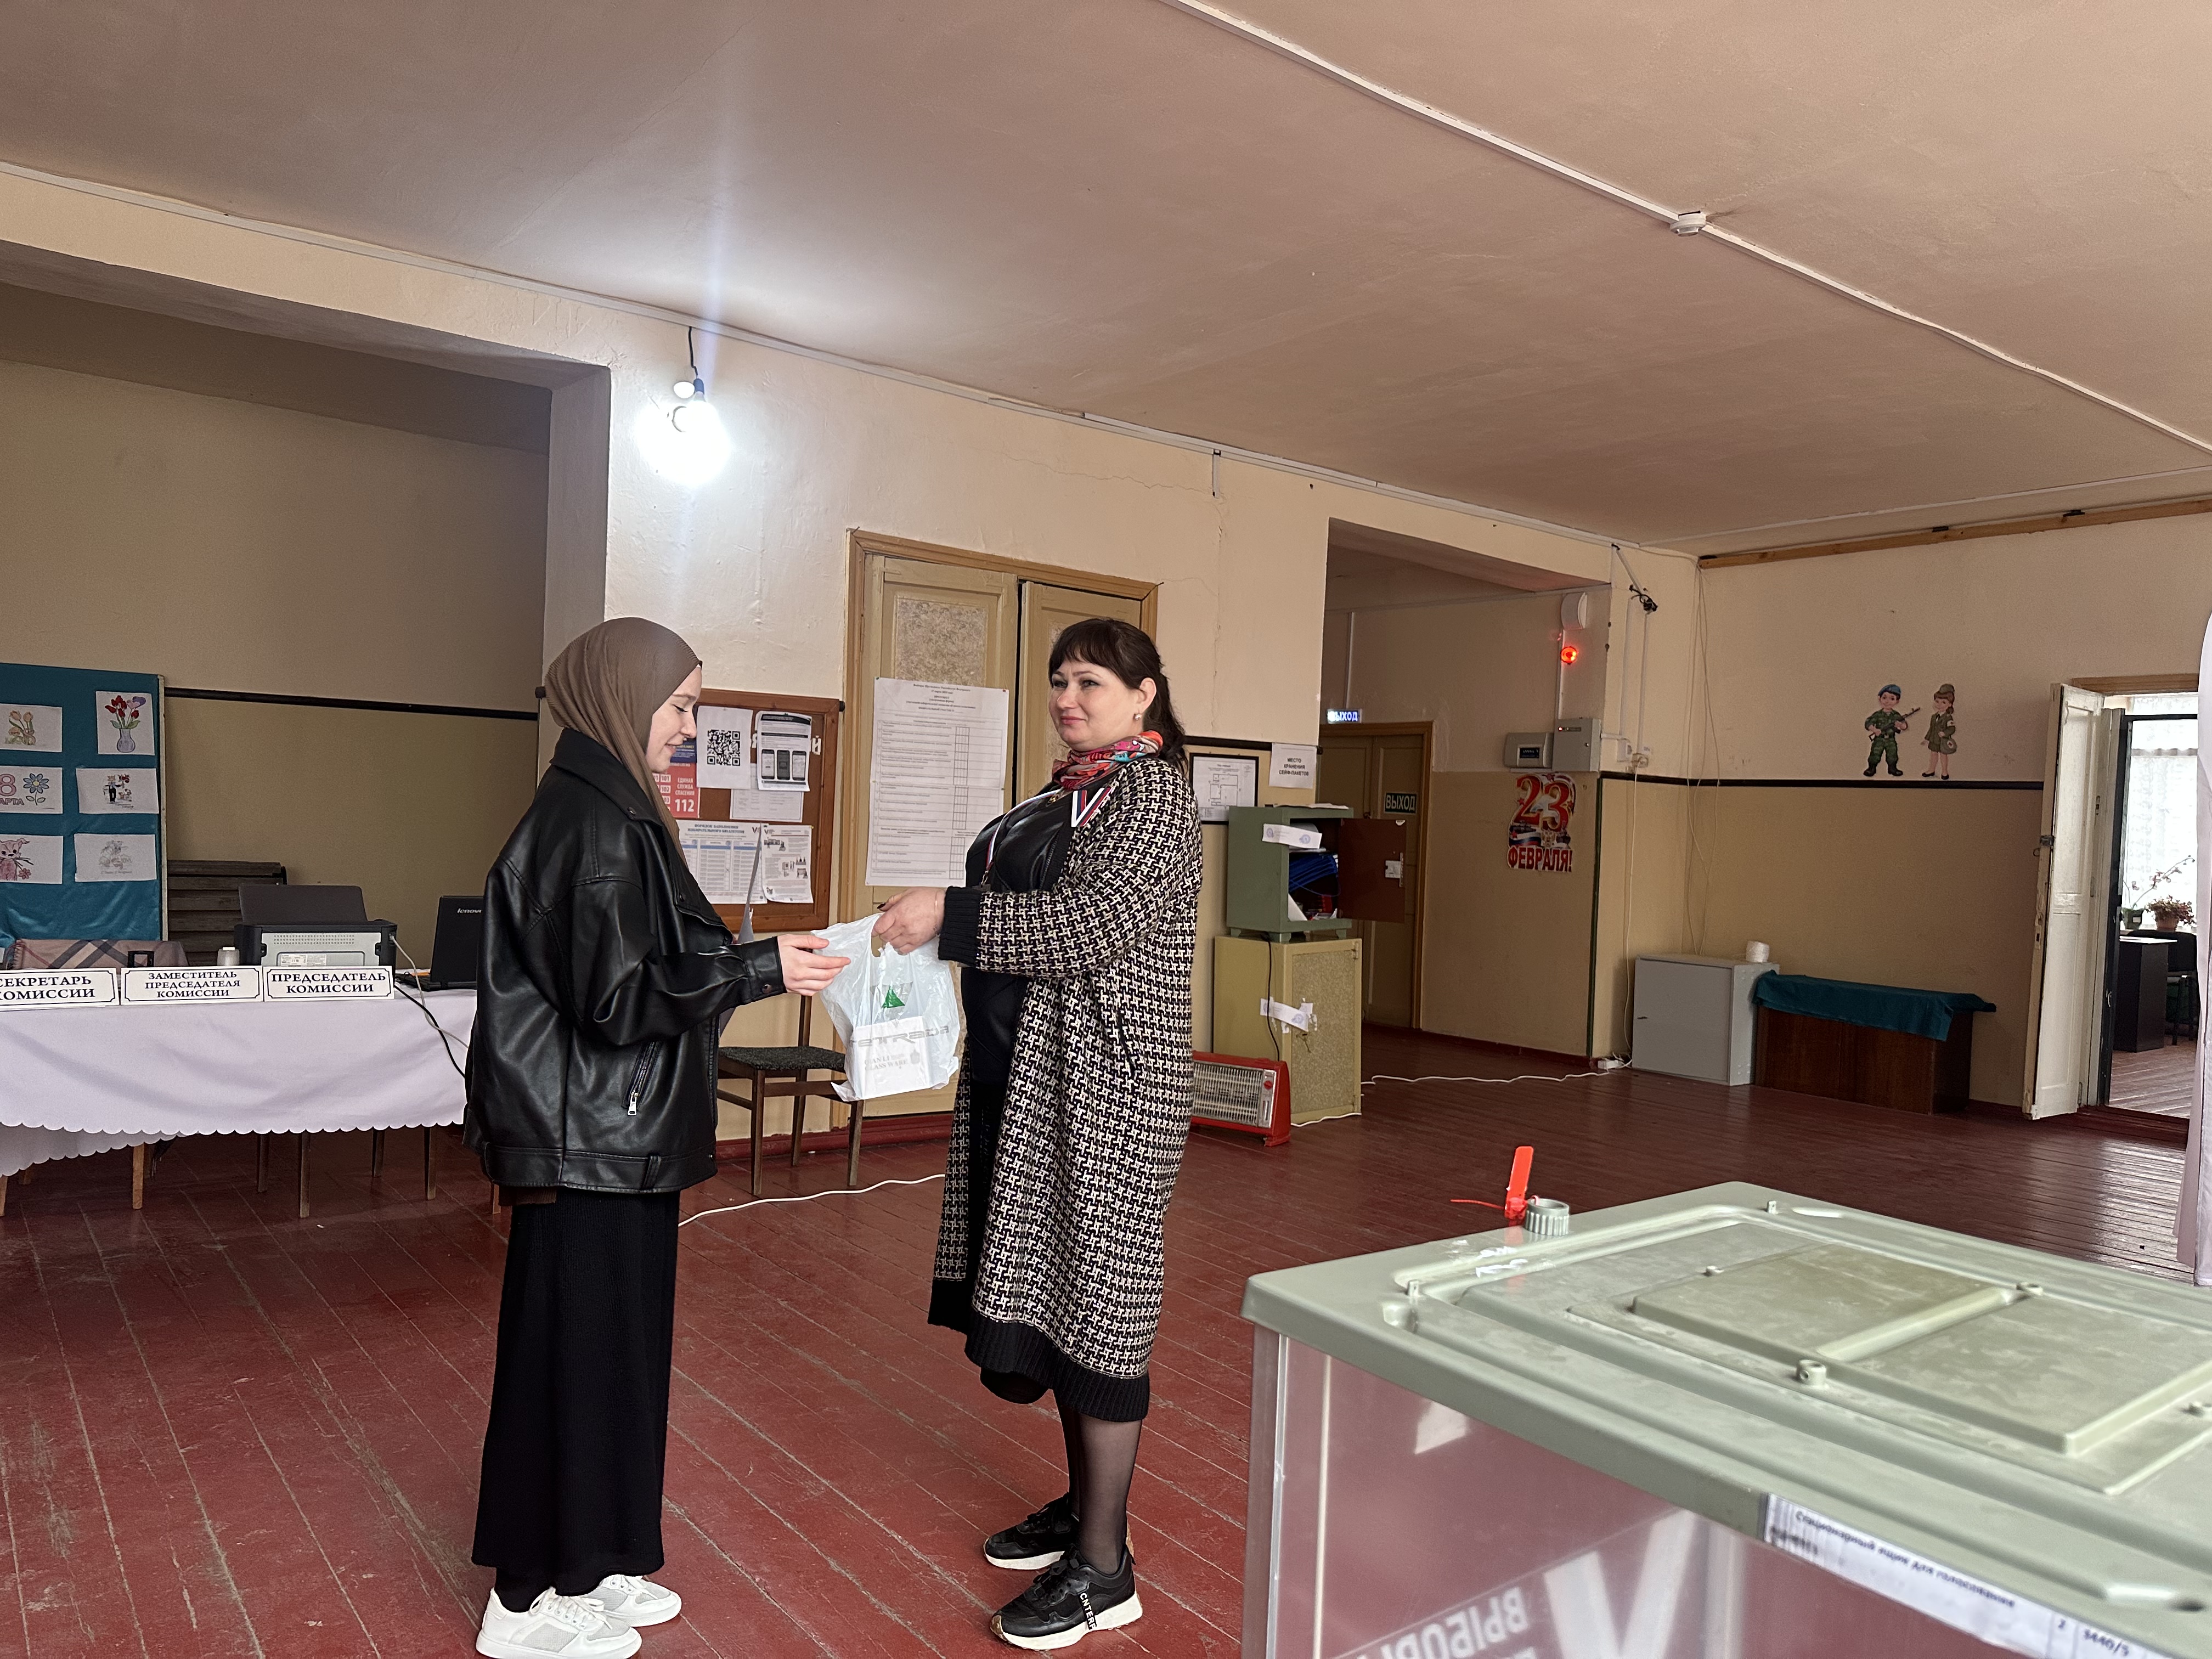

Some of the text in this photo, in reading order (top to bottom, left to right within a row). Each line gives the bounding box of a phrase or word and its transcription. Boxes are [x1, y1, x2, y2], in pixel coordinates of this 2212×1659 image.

[1328, 711, 1358, 722] ЫХОД
[0, 774, 17, 796] 8
[675, 799, 695, 812] 112
[1385, 794, 1416, 811] ВЫХОД
[1514, 774, 1571, 832] 23
[1509, 847, 1572, 872] ФЕВРАЛЯ!
[149, 971, 237, 980] ЗАМЕСТИТЕЛЬ
[272, 973, 386, 983] ПРЕДСЕДАТЕЛЬ
[145, 980, 240, 990] ПРЕДСЕДАТЕЛЯ
[286, 984, 374, 994] КОМИССИИ
[157, 990, 230, 998] КОМИССИИ
[1911, 1561, 1934, 1575] для
